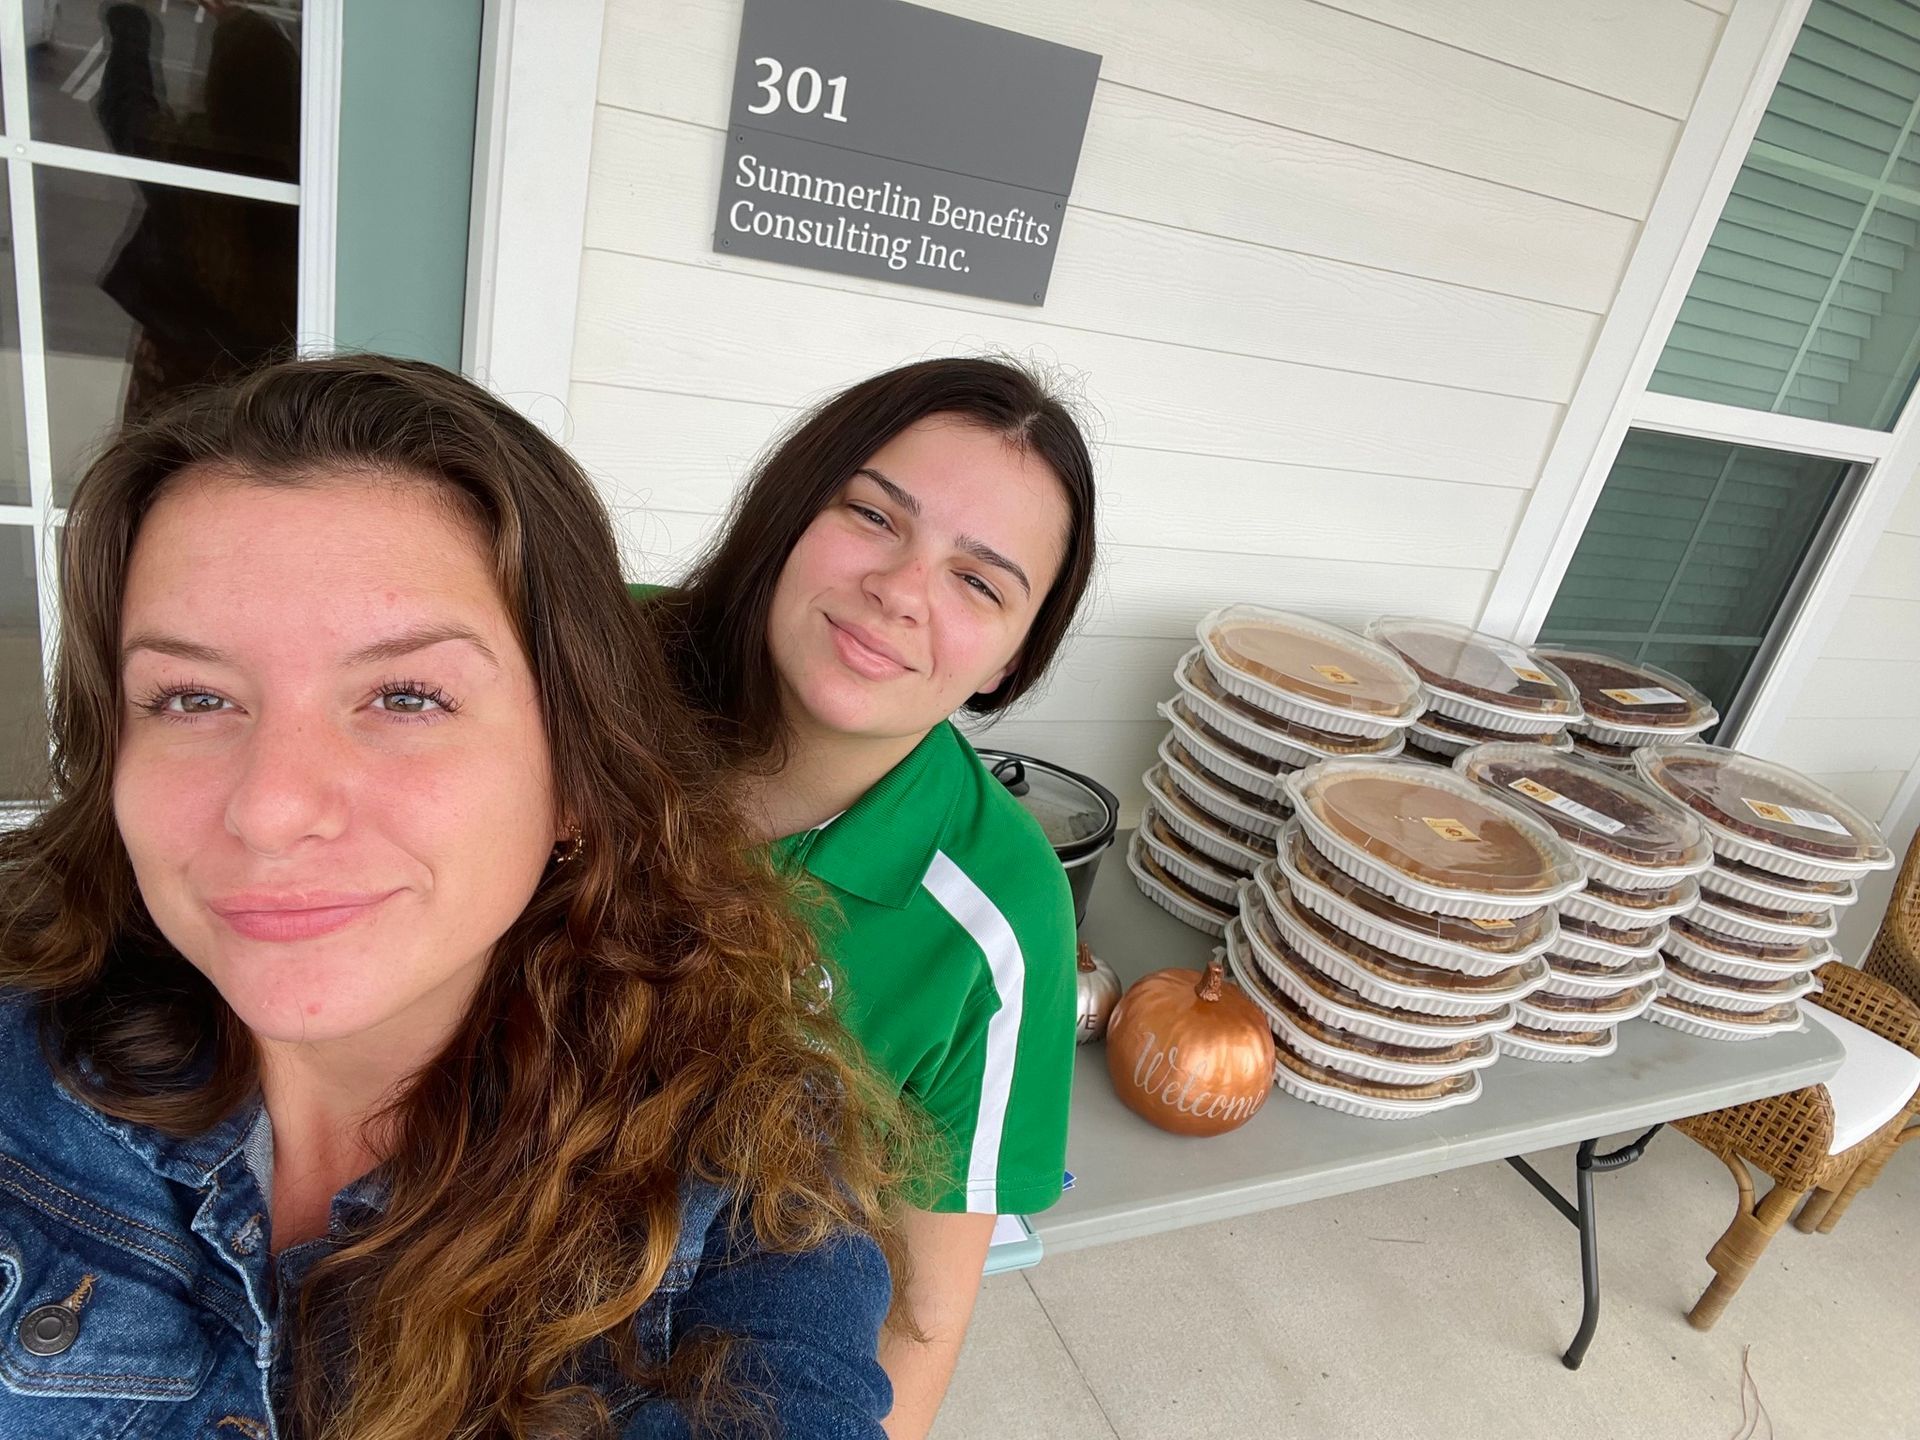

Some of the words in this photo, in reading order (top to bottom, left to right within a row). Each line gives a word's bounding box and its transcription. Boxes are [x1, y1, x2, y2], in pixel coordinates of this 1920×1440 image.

[747, 57, 848, 123] 301
[735, 155, 921, 222] Summerlin
[927, 195, 1050, 246] Benefits
[729, 201, 912, 270] Consulting
[915, 235, 970, 273] Inc.
